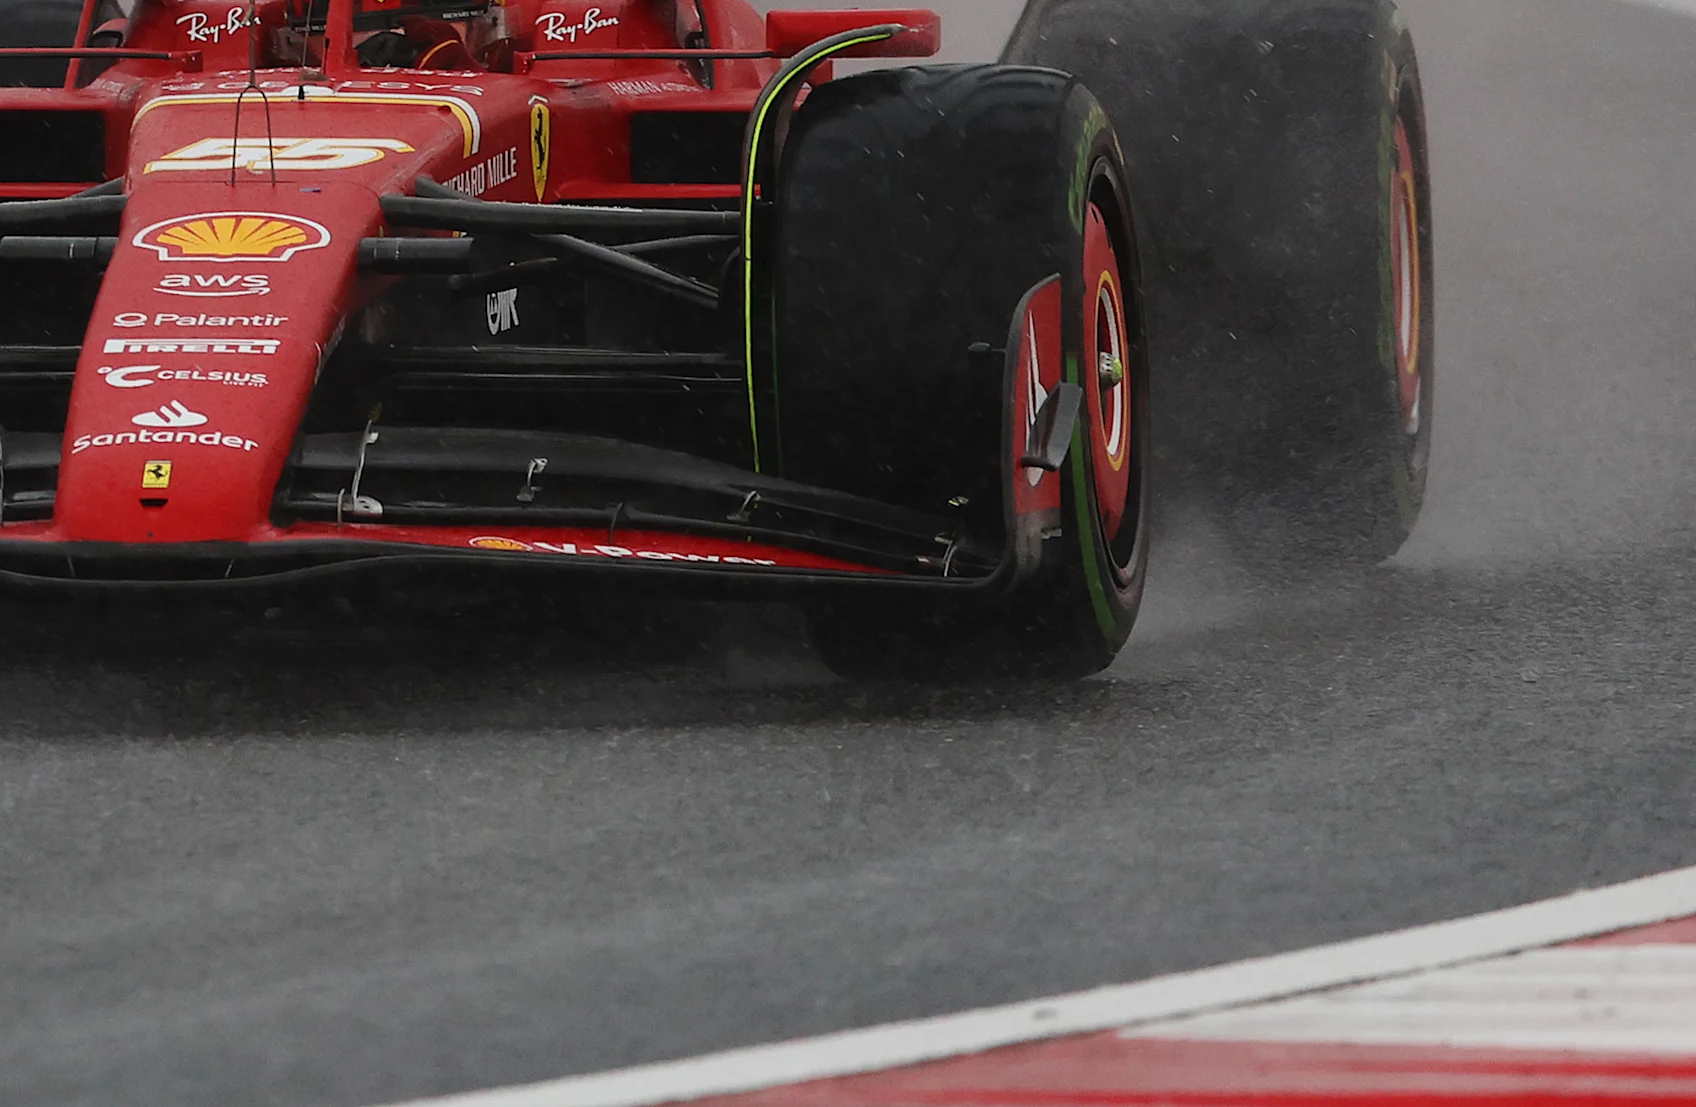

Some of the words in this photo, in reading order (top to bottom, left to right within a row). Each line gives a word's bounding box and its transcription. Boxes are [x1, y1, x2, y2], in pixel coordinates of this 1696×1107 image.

[535, 8, 619, 42] Ray-Ban
[143, 138, 415, 174] 55
[442, 163, 484, 197] CHARD
[487, 146, 517, 189] MILLE
[154, 314, 288, 326] Palantir
[103, 339, 281, 354] PIRELLI
[157, 370, 267, 383] CELSIUS
[72, 429, 259, 455] Santander
[532, 542, 776, 566] V-Power
